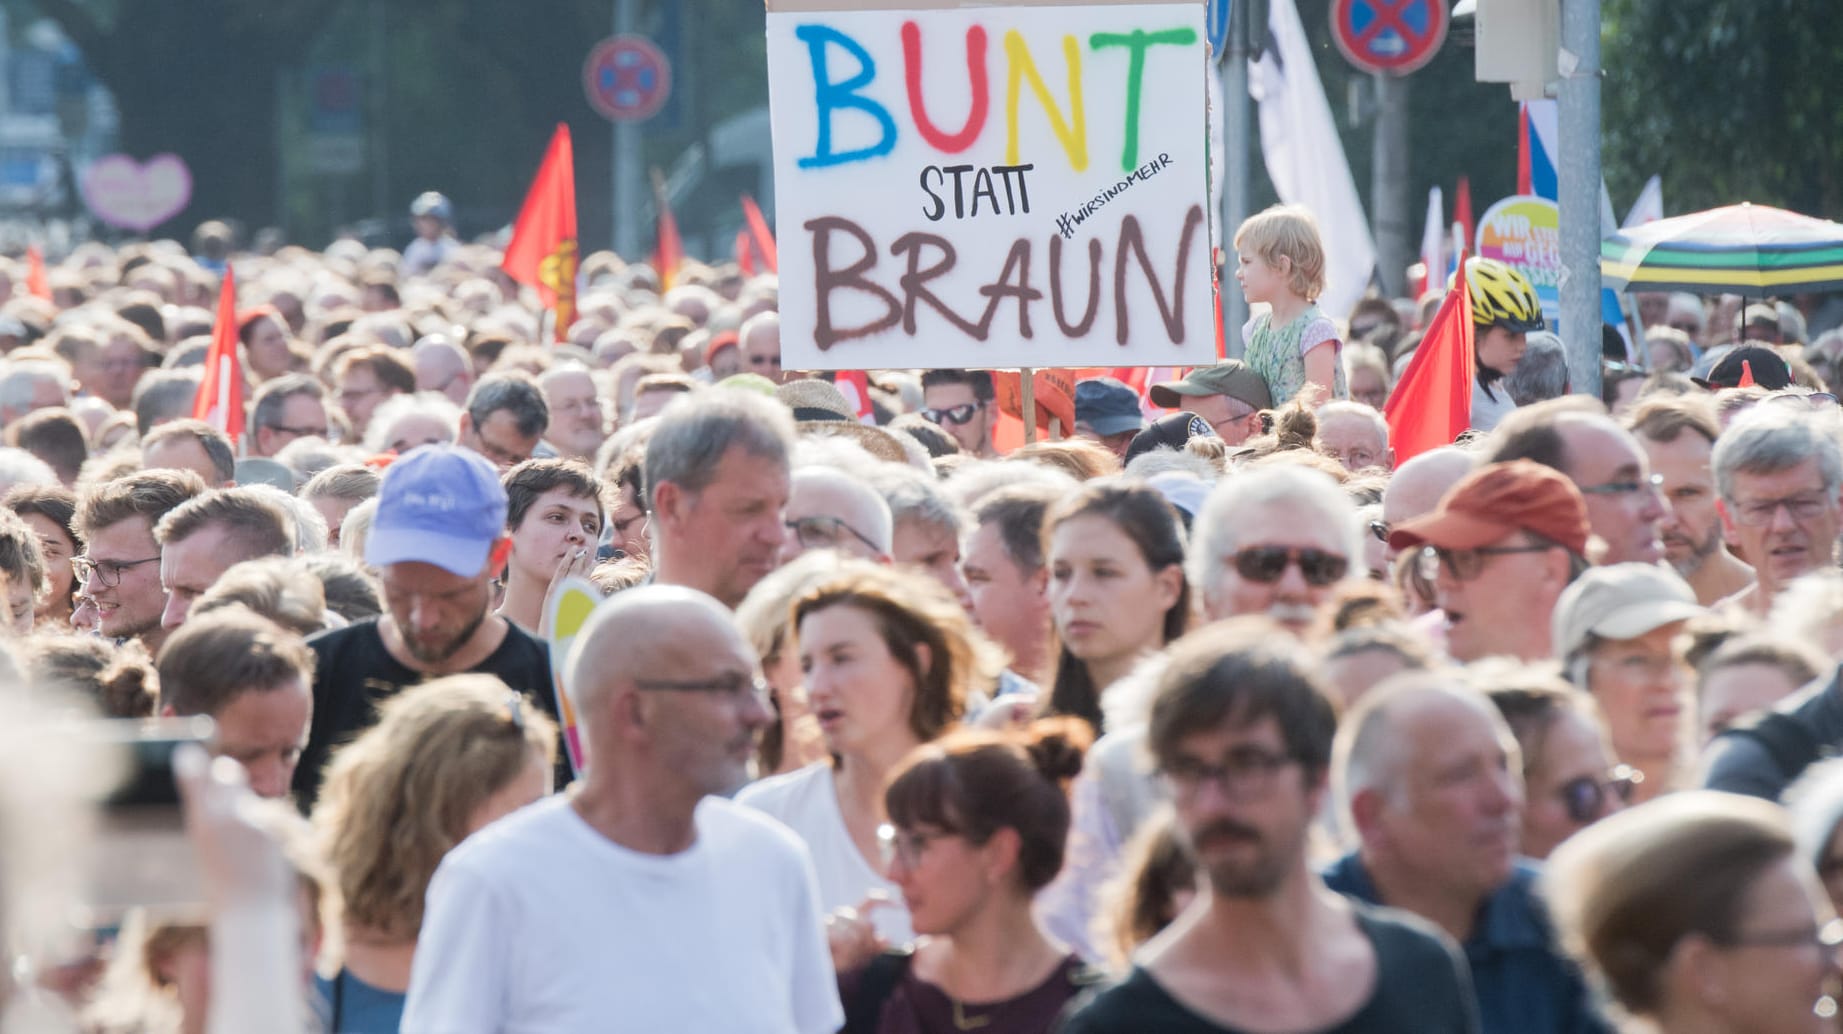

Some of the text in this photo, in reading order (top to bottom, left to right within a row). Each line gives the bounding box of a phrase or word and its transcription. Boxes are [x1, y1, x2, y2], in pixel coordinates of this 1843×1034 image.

[796, 20, 1197, 172] BUNT
[920, 163, 1034, 221] STATT
[804, 204, 1204, 351] BRAUN
